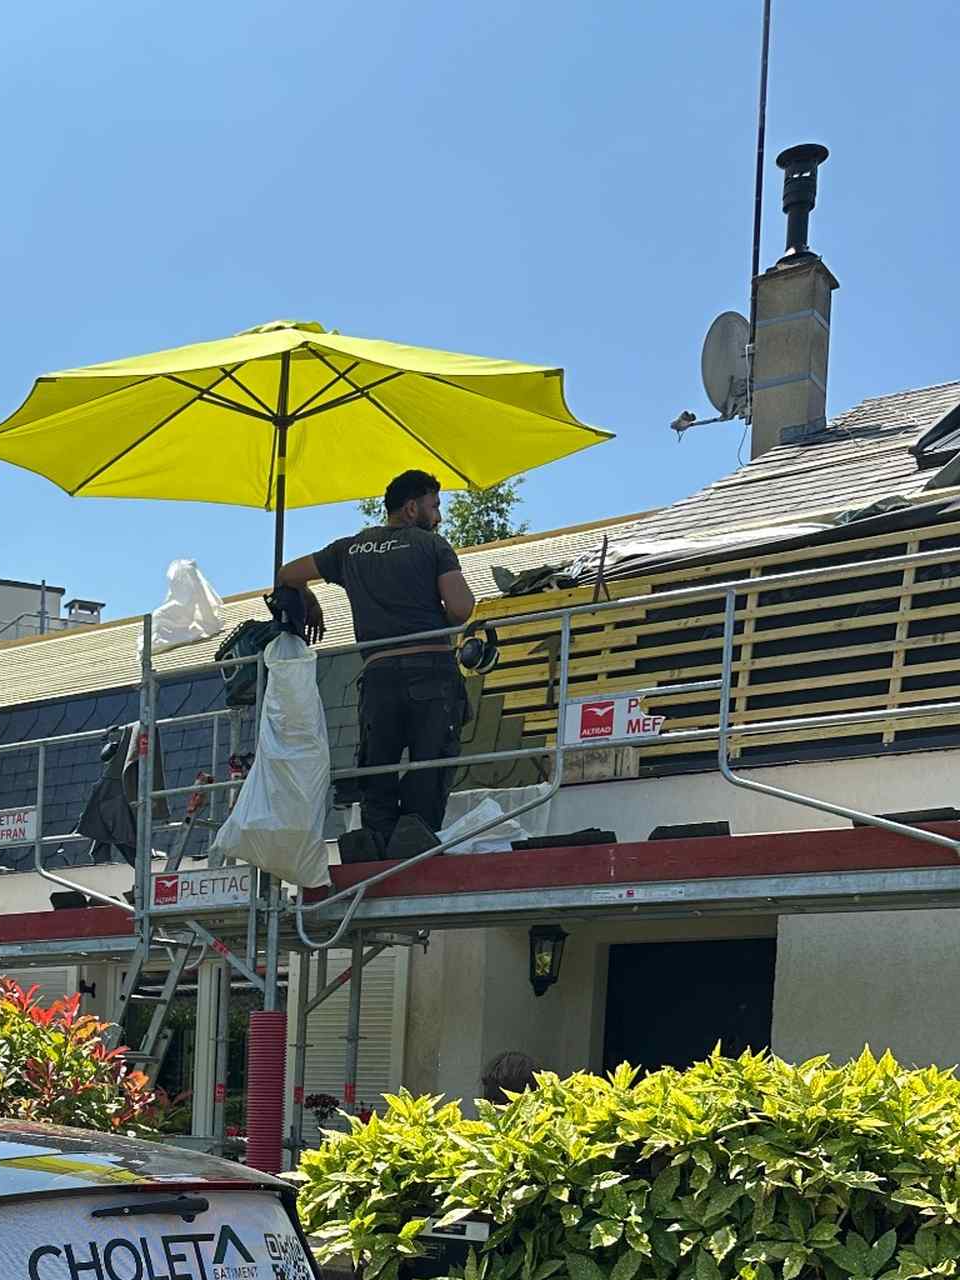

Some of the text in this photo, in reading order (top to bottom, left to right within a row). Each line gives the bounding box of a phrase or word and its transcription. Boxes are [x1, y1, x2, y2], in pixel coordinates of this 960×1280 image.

[348, 540, 398, 555] CHOLET
[581, 726, 612, 737] ALTRAD
[626, 717, 661, 735] MEF
[180, 875, 249, 898] PLETTAC
[212, 1265, 258, 1280] BATIMENT
